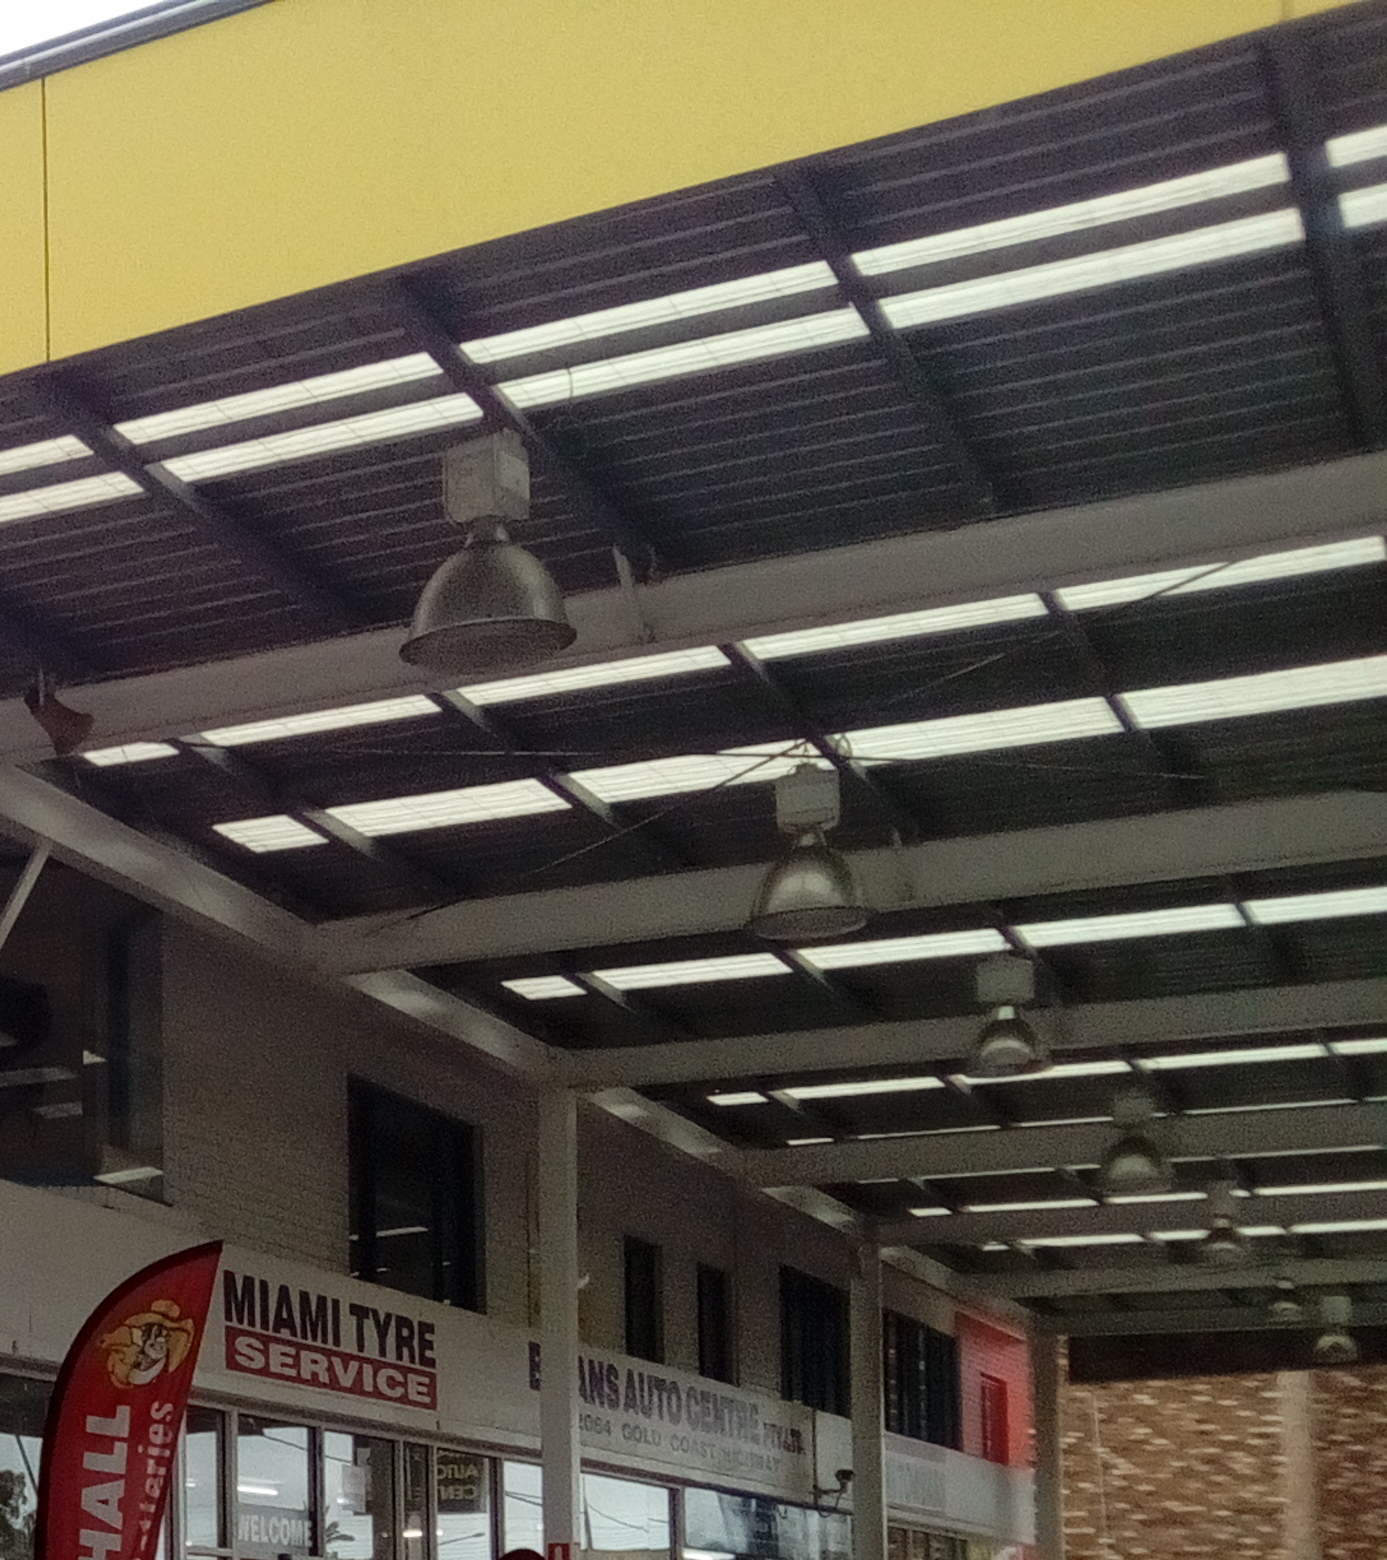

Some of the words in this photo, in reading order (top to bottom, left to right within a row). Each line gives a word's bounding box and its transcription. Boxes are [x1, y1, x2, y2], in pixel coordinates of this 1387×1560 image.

[223, 1268, 341, 1348] MIAMI
[349, 1302, 436, 1370] TYRE
[234, 1335, 432, 1404] SERVICE
[623, 1368, 682, 1427] AUTO
[622, 1422, 662, 1447] GOLD
[238, 1513, 313, 1548] WELCOME
